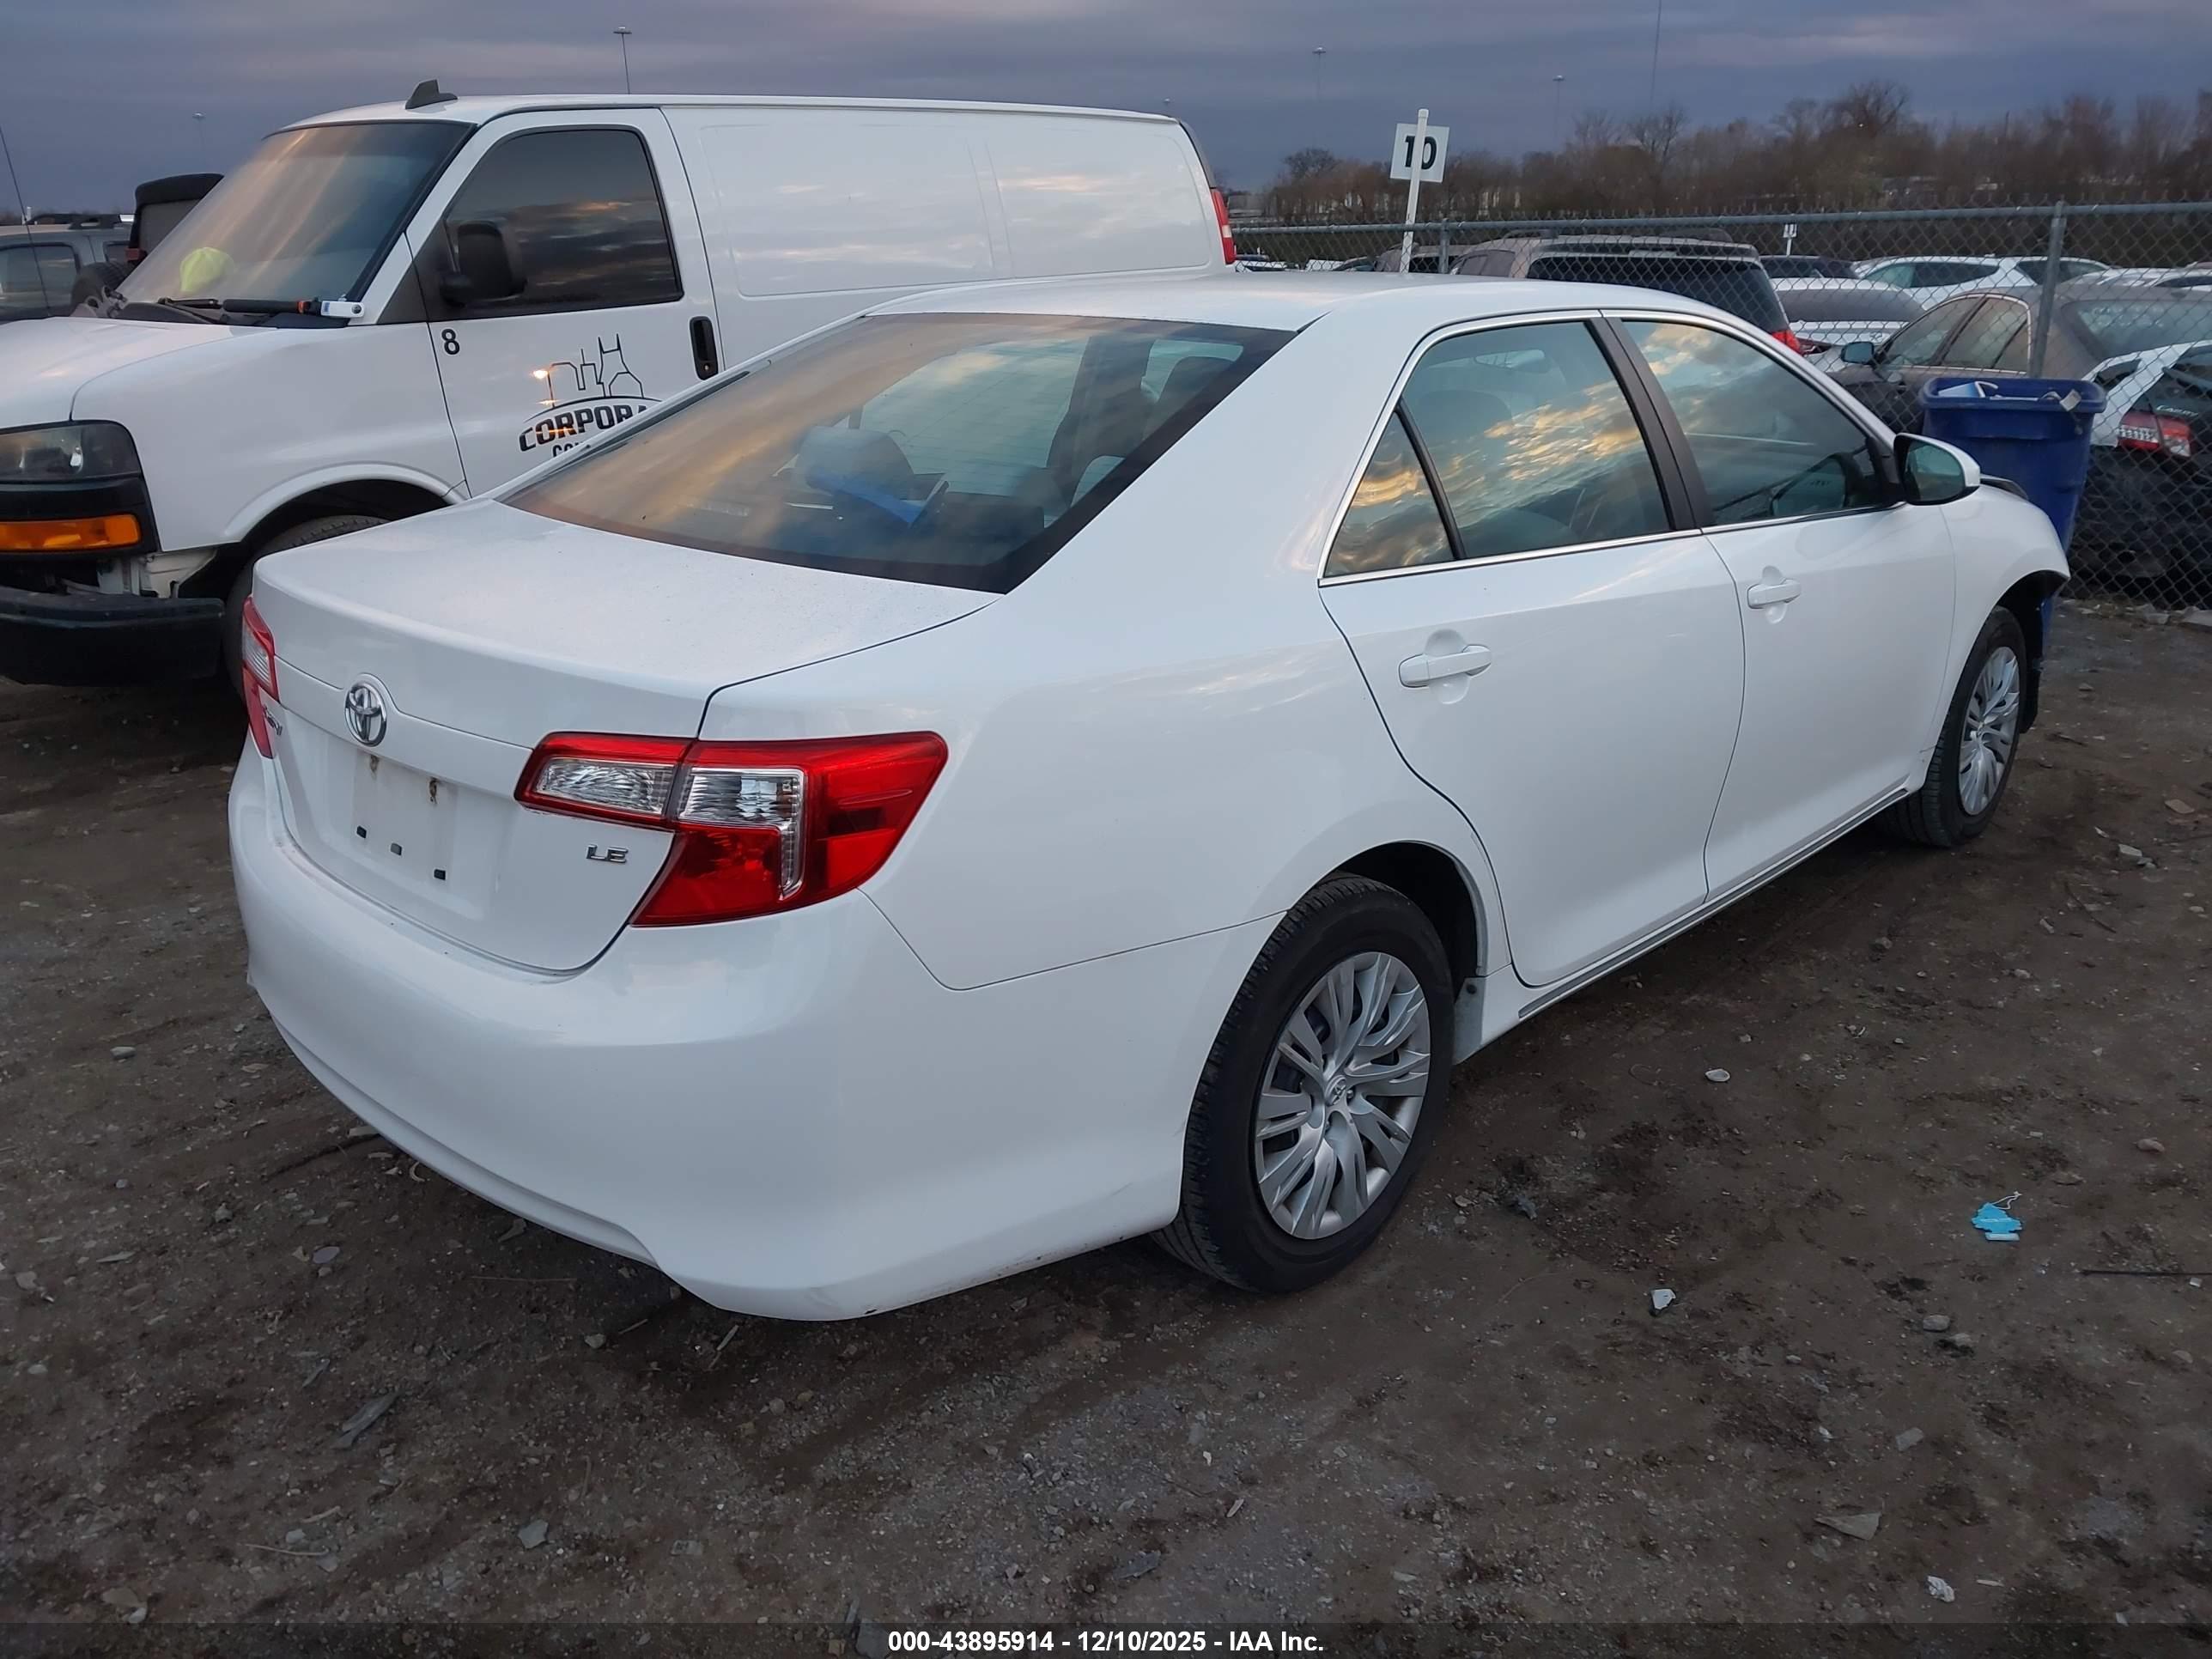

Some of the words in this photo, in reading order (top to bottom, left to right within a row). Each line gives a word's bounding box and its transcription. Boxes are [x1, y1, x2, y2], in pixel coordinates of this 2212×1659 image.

[1405, 135, 1437, 169] 10
[441, 328, 460, 355] 8
[586, 844, 629, 864] LE
